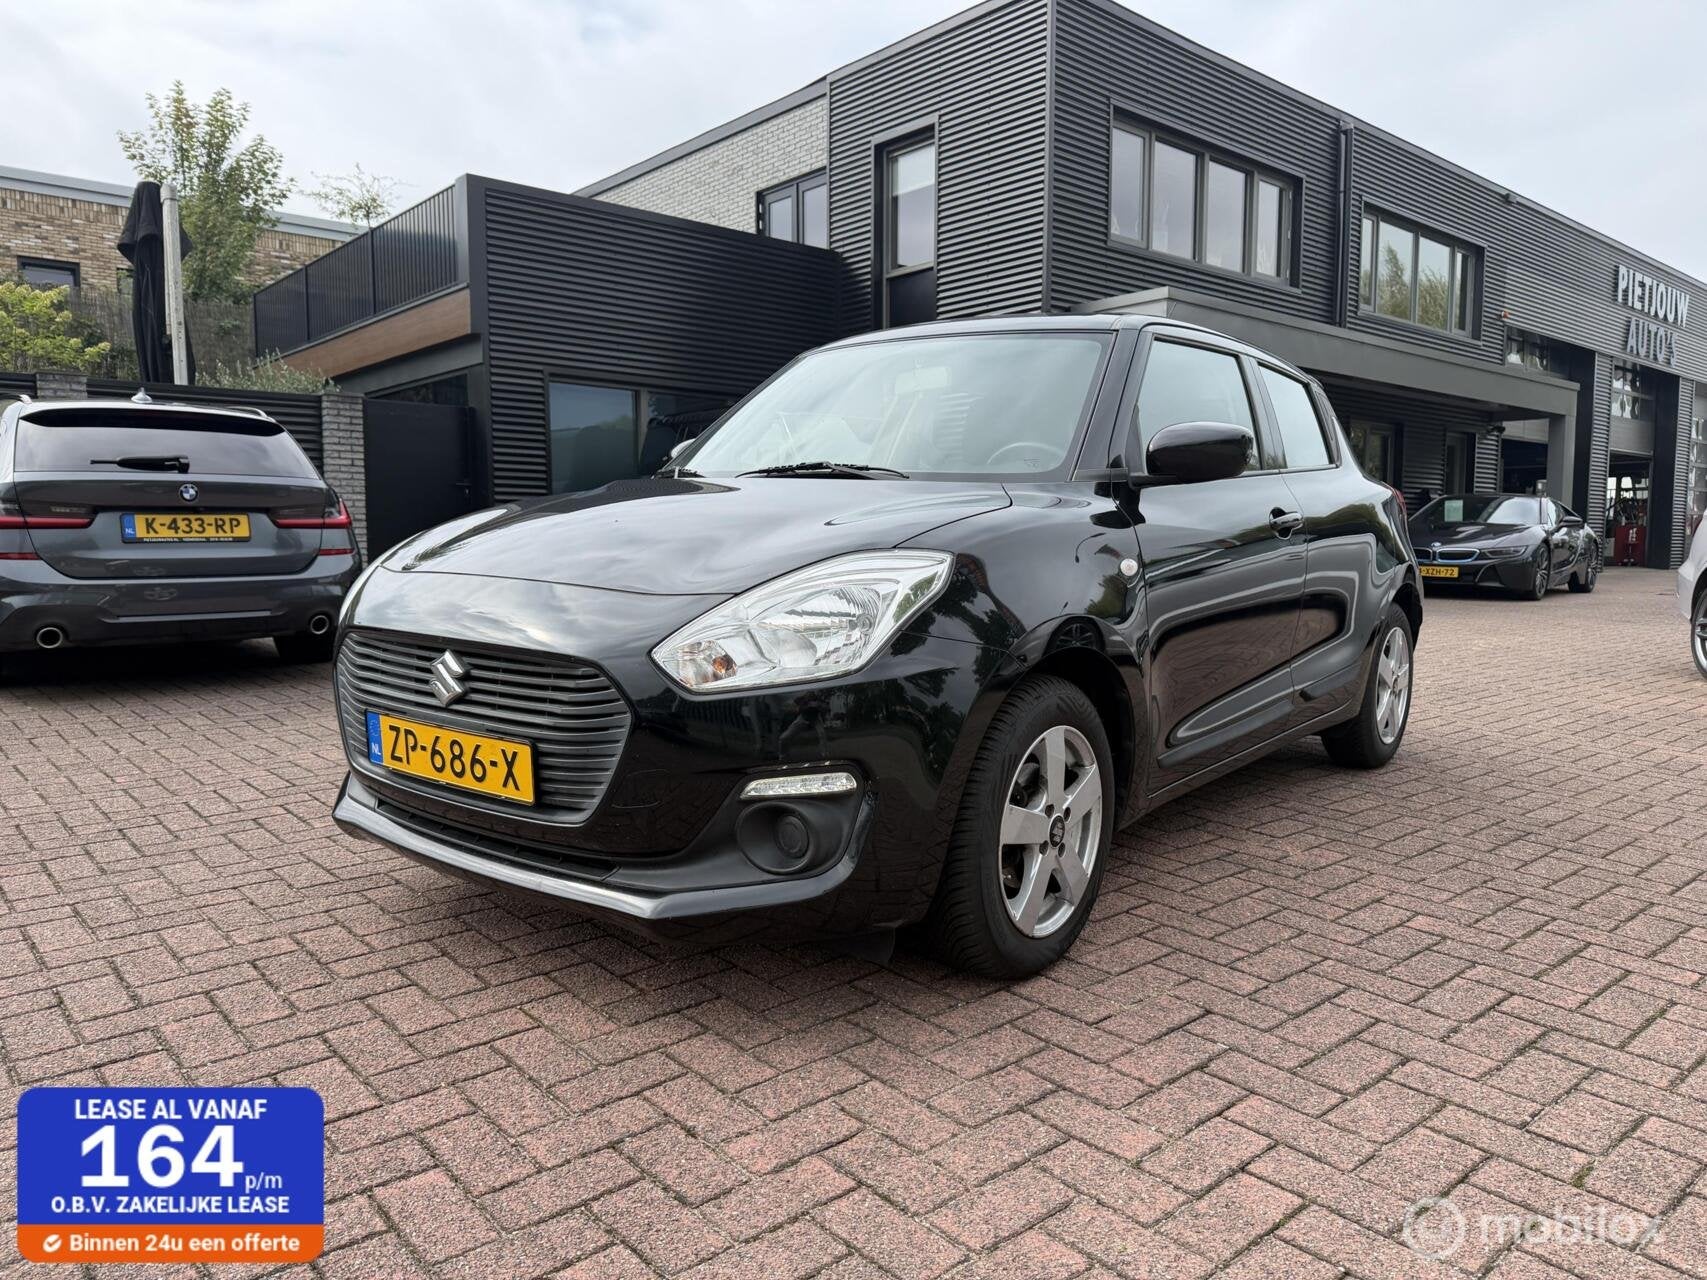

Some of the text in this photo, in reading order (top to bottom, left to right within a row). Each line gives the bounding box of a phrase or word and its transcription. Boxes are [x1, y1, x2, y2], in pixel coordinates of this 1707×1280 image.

[1617, 264, 1690, 328] PIETJOUW
[1627, 316, 1678, 369] AUTO'S
[144, 517, 241, 535] K-433-RP
[371, 724, 521, 792] NL ZP-686-X
